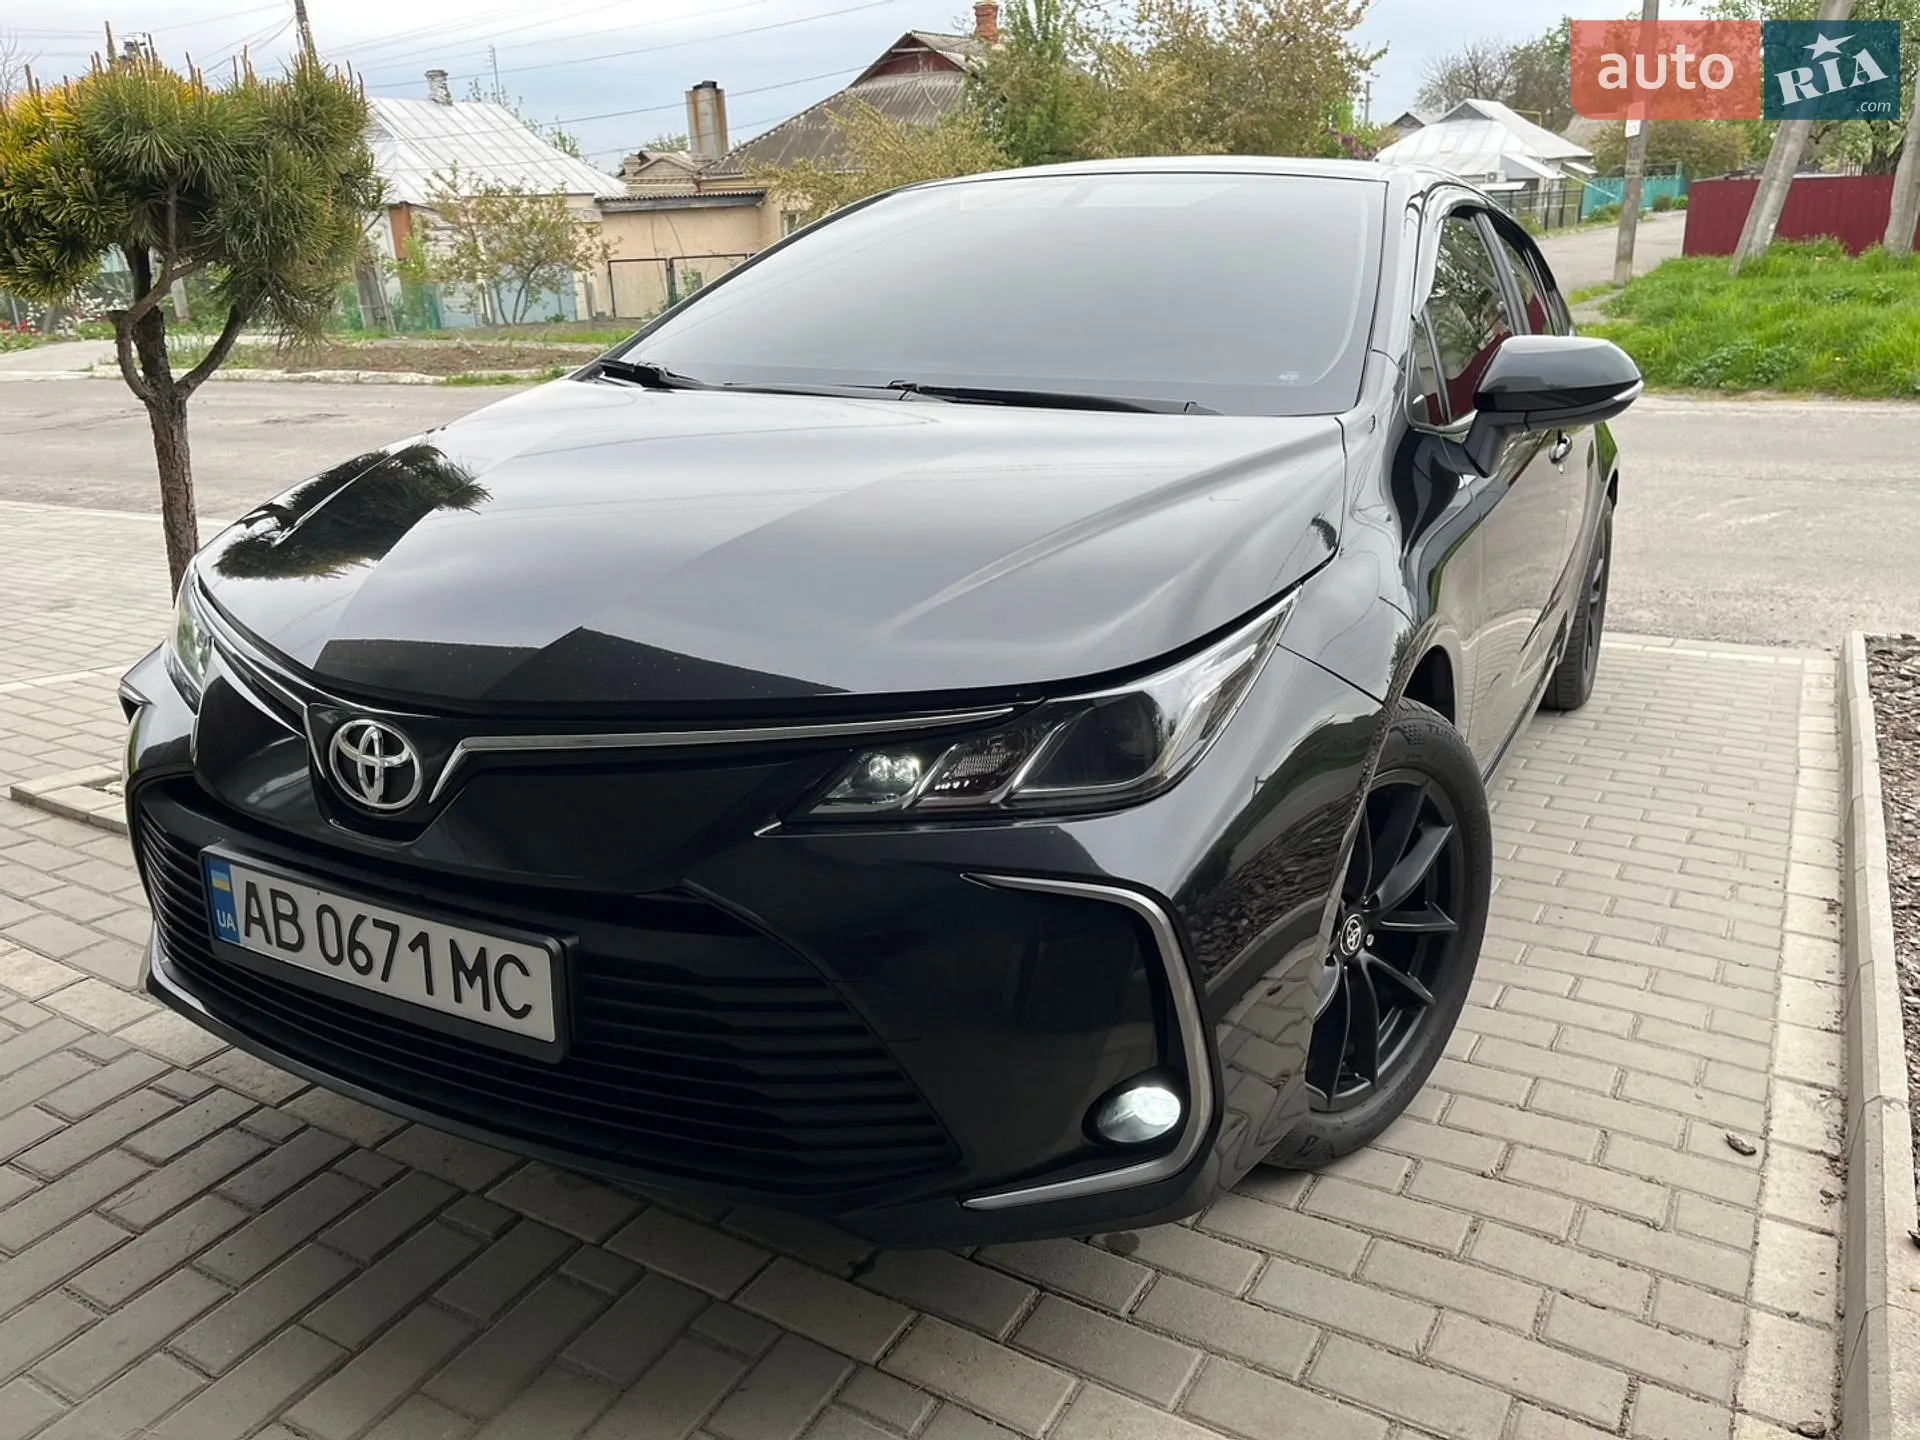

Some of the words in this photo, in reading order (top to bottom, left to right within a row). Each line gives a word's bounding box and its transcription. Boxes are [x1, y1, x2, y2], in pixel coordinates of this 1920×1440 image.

[216, 909, 237, 932] UA
[243, 880, 305, 953] AB
[316, 904, 434, 996] 0671
[449, 938, 532, 1020] MC
